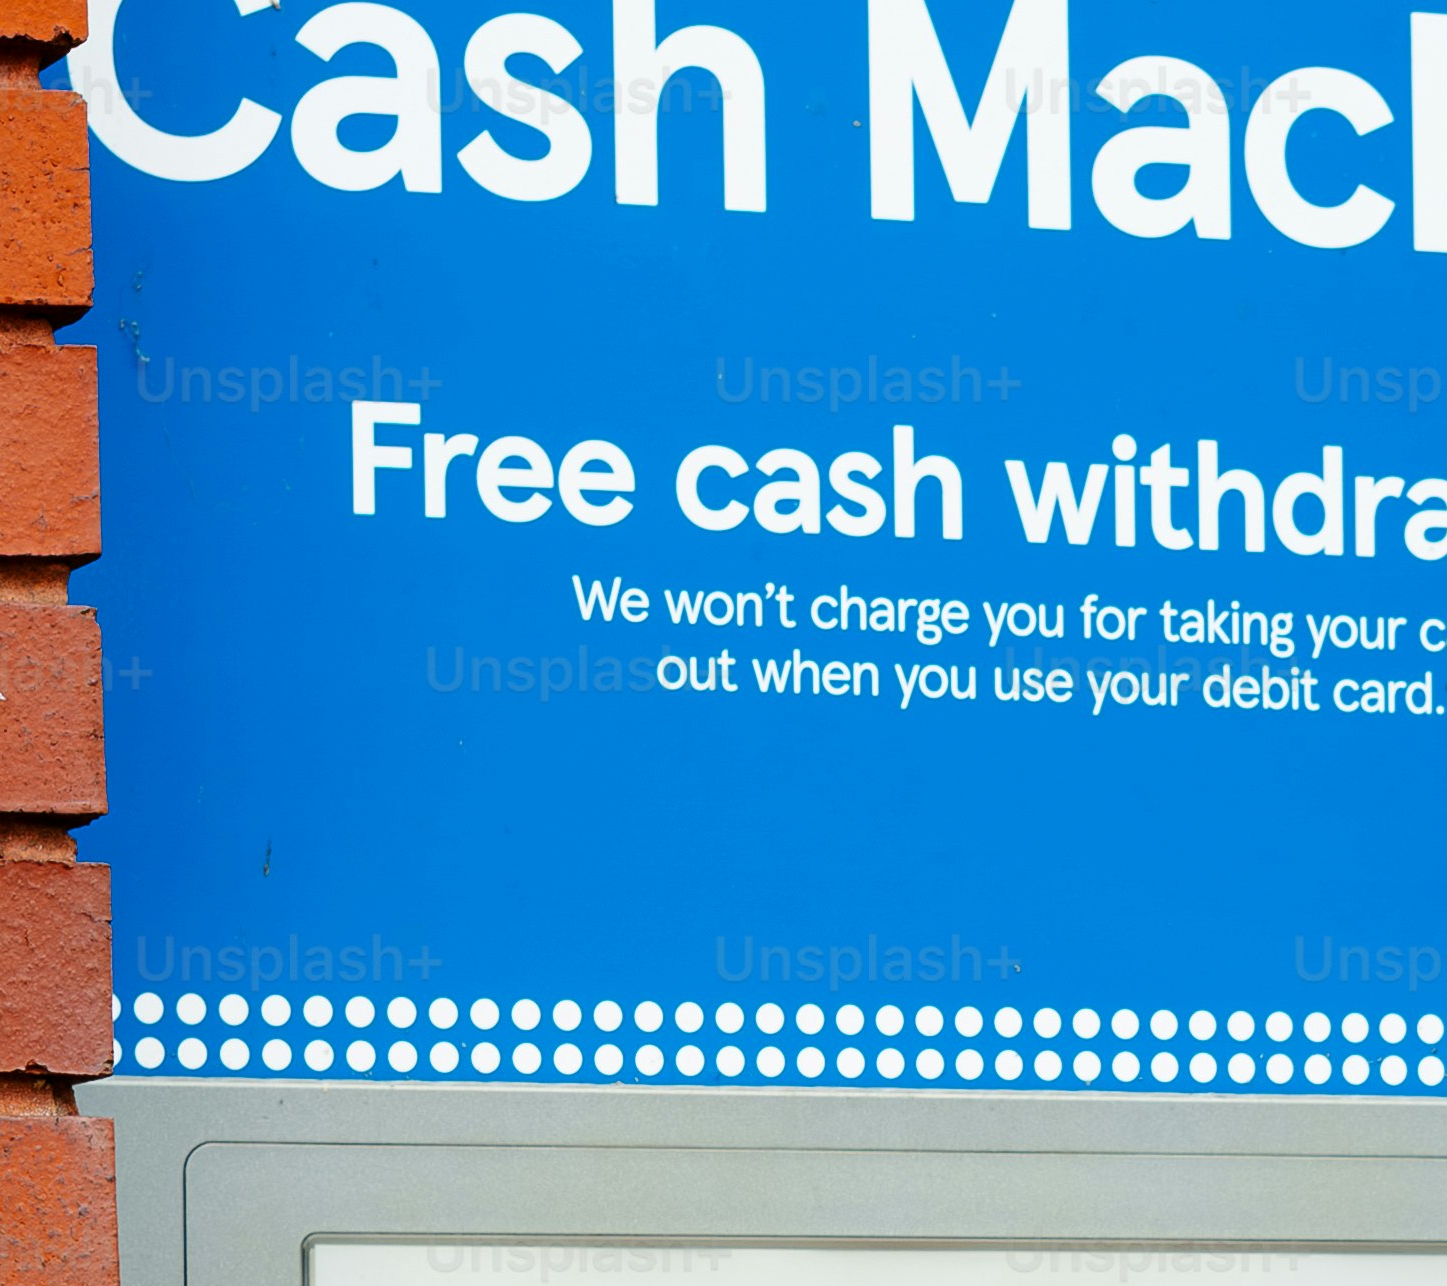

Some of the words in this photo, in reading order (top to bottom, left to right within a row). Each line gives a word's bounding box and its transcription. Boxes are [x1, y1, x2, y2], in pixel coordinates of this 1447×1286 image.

[66, 0, 767, 212] Cash
[351, 400, 636, 527] Free
[676, 425, 963, 540] cash
[572, 575, 650, 623] We
[664, 583, 797, 628] won’t
[810, 585, 970, 646] charge
[982, 602, 1064, 647] you
[1080, 594, 1147, 641] for
[1159, 600, 1295, 658] taking
[1306, 615, 1407, 659] your
[656, 650, 738, 692] out
[752, 649, 879, 697] when
[894, 664, 976, 710] you
[994, 668, 1074, 703] use
[1086, 671, 1190, 716] your
[1202, 664, 1320, 711] debit
[1333, 671, 1445, 715] card.
